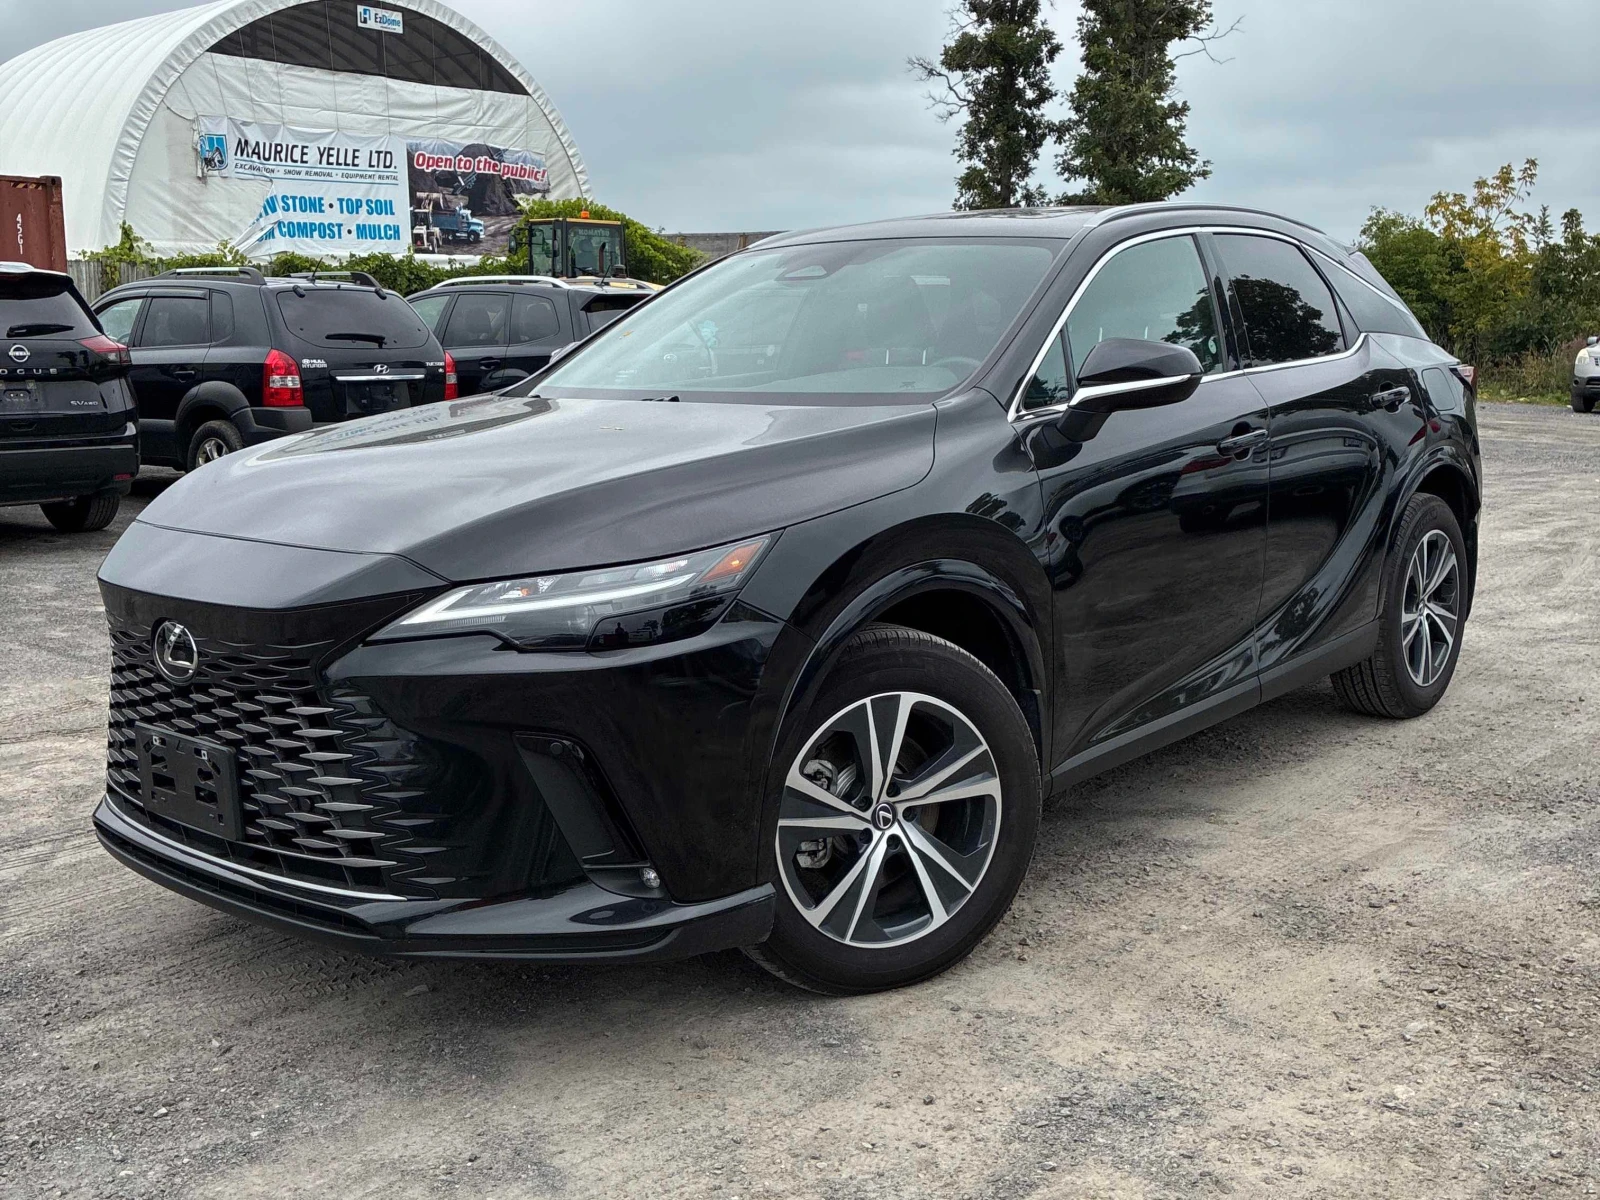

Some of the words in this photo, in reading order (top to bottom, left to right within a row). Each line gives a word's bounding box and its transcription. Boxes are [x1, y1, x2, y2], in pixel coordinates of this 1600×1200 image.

[374, 13, 401, 26] EzDome
[234, 137, 309, 164] MAURICE
[316, 146, 360, 168] YELLE
[368, 149, 398, 170] LTD.
[234, 162, 275, 174] EXCAVATION
[283, 168, 302, 176] SNOW
[304, 170, 333, 178] REMOVAL
[341, 172, 376, 180] EQUIPMENT
[415, 151, 453, 171] Open
[456, 154, 473, 171] to
[475, 156, 500, 173] the
[501, 163, 547, 182] public!
[280, 194, 325, 213] STONE
[336, 197, 363, 215] TOP
[365, 198, 395, 216] SOIL
[277, 220, 343, 240] COMPOST
[355, 223, 400, 240] MULCH
